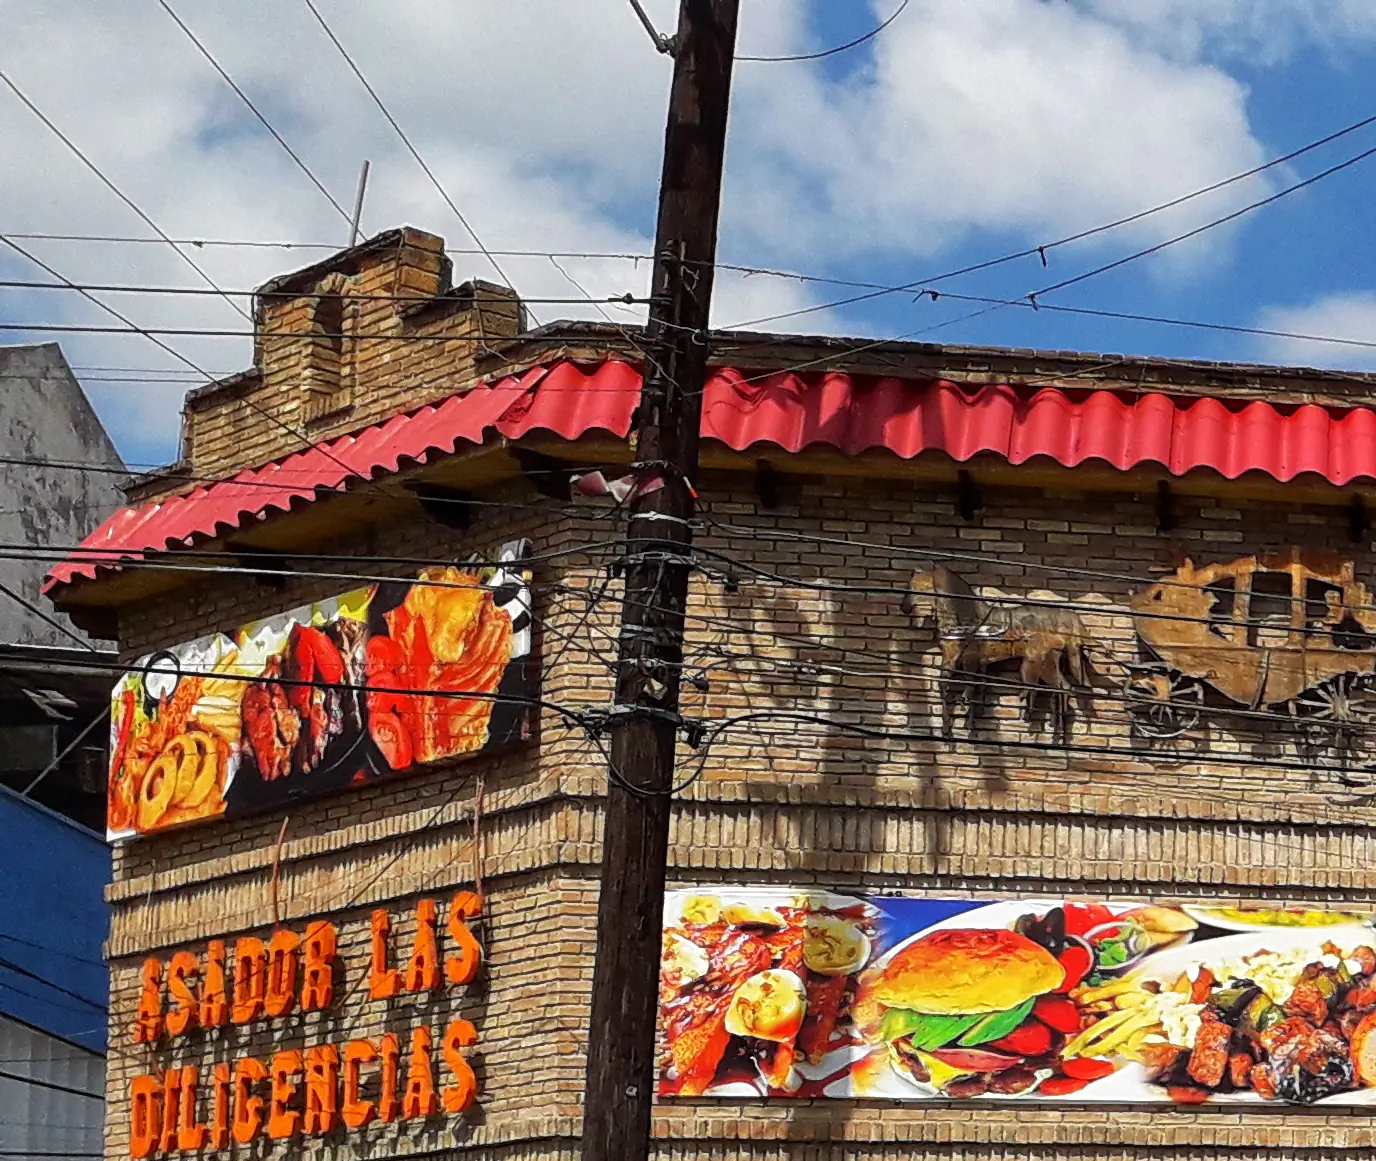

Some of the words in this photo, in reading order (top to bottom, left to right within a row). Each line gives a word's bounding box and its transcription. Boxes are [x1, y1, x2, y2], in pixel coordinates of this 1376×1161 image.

[134, 920, 336, 1042] ASADOR
[370, 890, 484, 999] LAS
[129, 1018, 479, 1159] DILIGENCIAS
